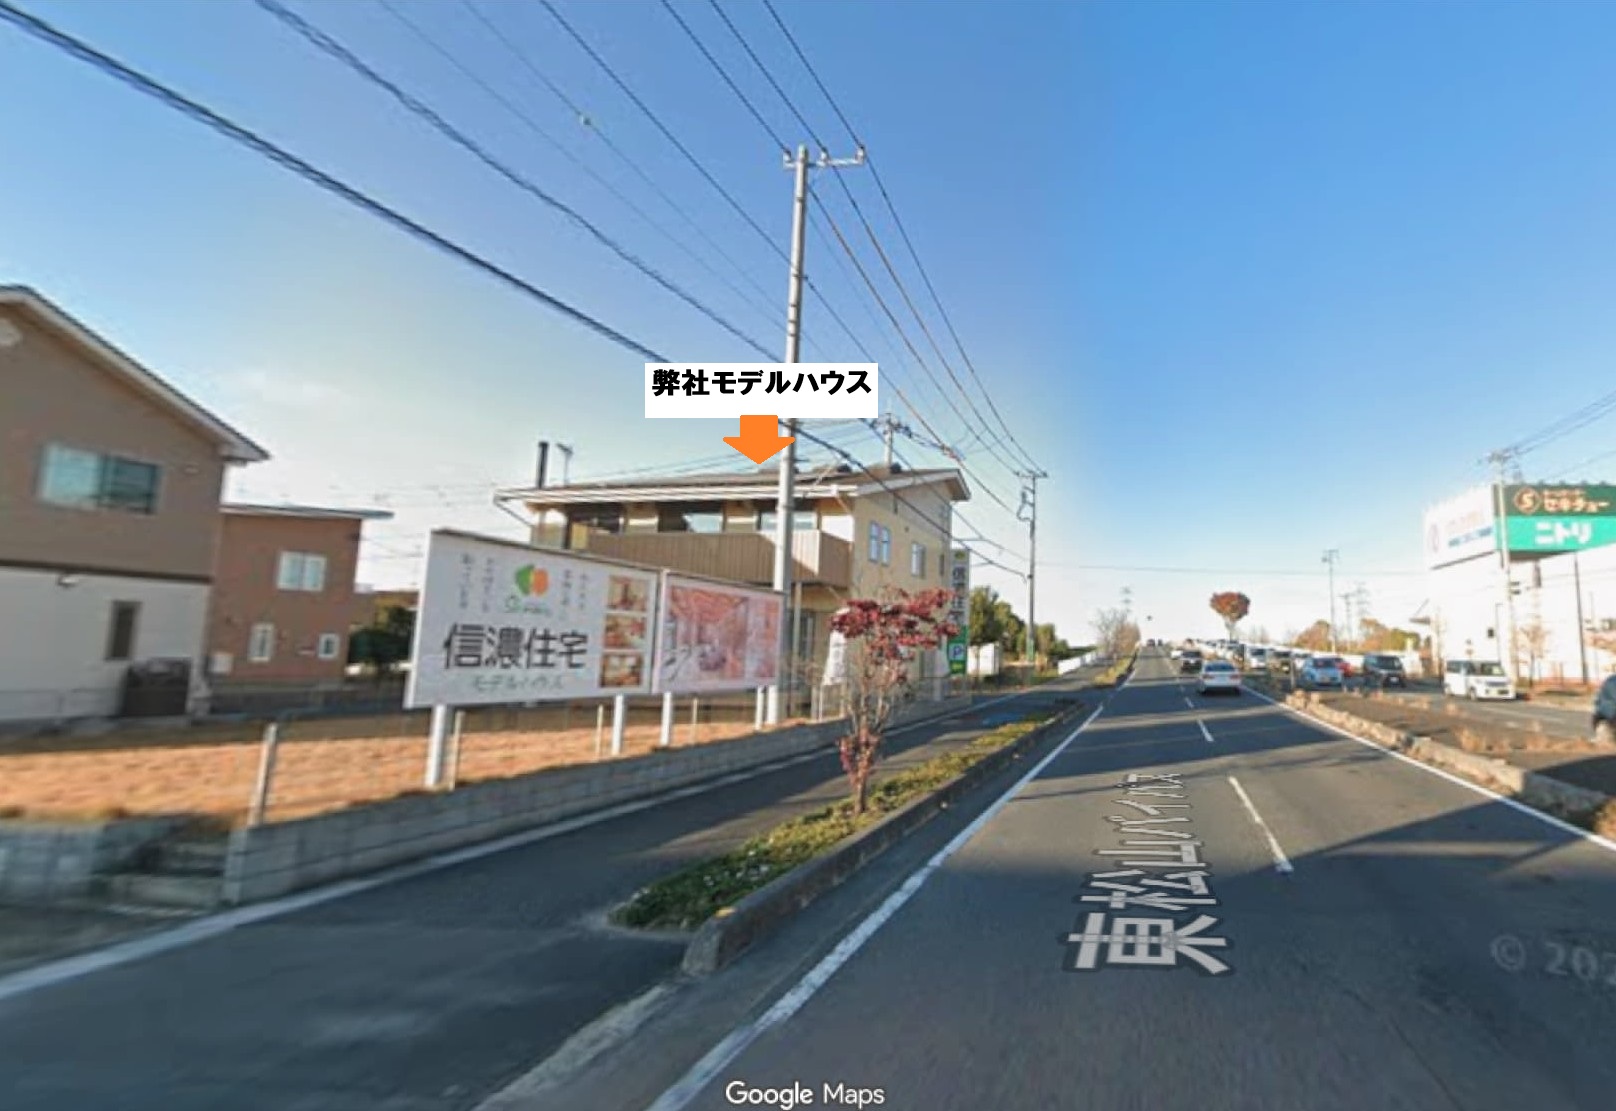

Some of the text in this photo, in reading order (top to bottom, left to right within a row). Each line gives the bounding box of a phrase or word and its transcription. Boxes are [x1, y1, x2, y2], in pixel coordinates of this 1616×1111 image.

[1535, 522, 1591, 544] ニトリ
[444, 623, 587, 669] 信濃住宅
